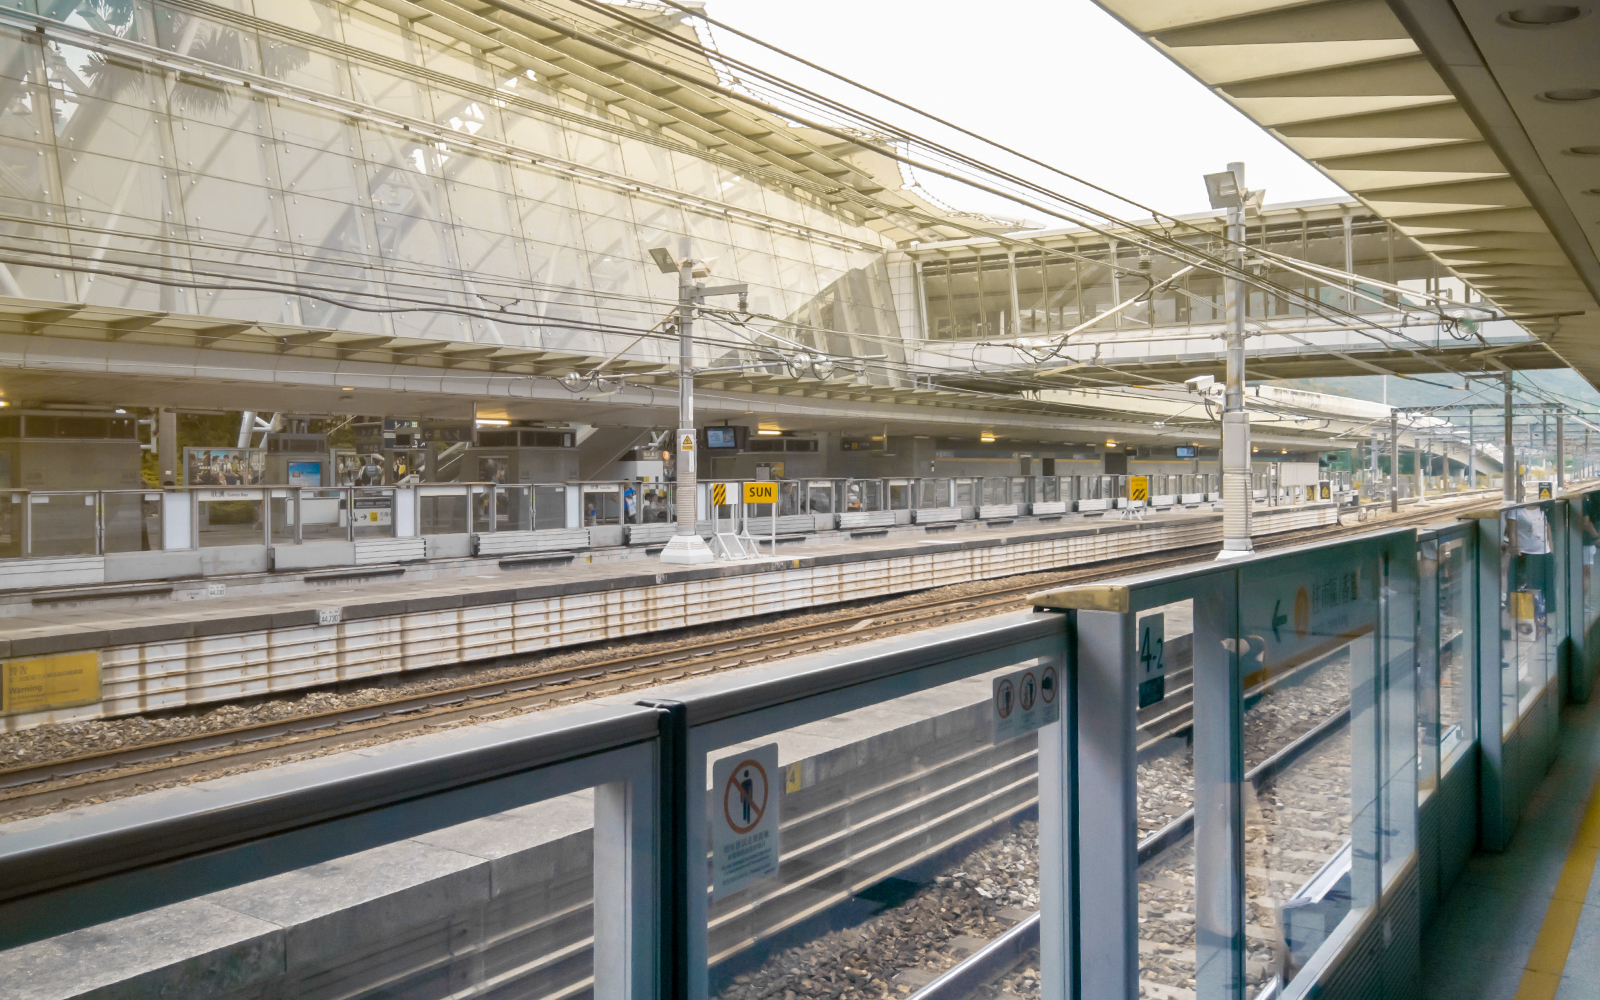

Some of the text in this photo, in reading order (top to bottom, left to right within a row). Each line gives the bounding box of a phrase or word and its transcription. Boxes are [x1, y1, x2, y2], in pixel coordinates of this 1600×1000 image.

[749, 487, 772, 497] SUN
[321, 614, 339, 623] 44.730
[1140, 626, 1163, 673] 4-2
[9, 685, 43, 695] Warning
[789, 767, 796, 785] 4
